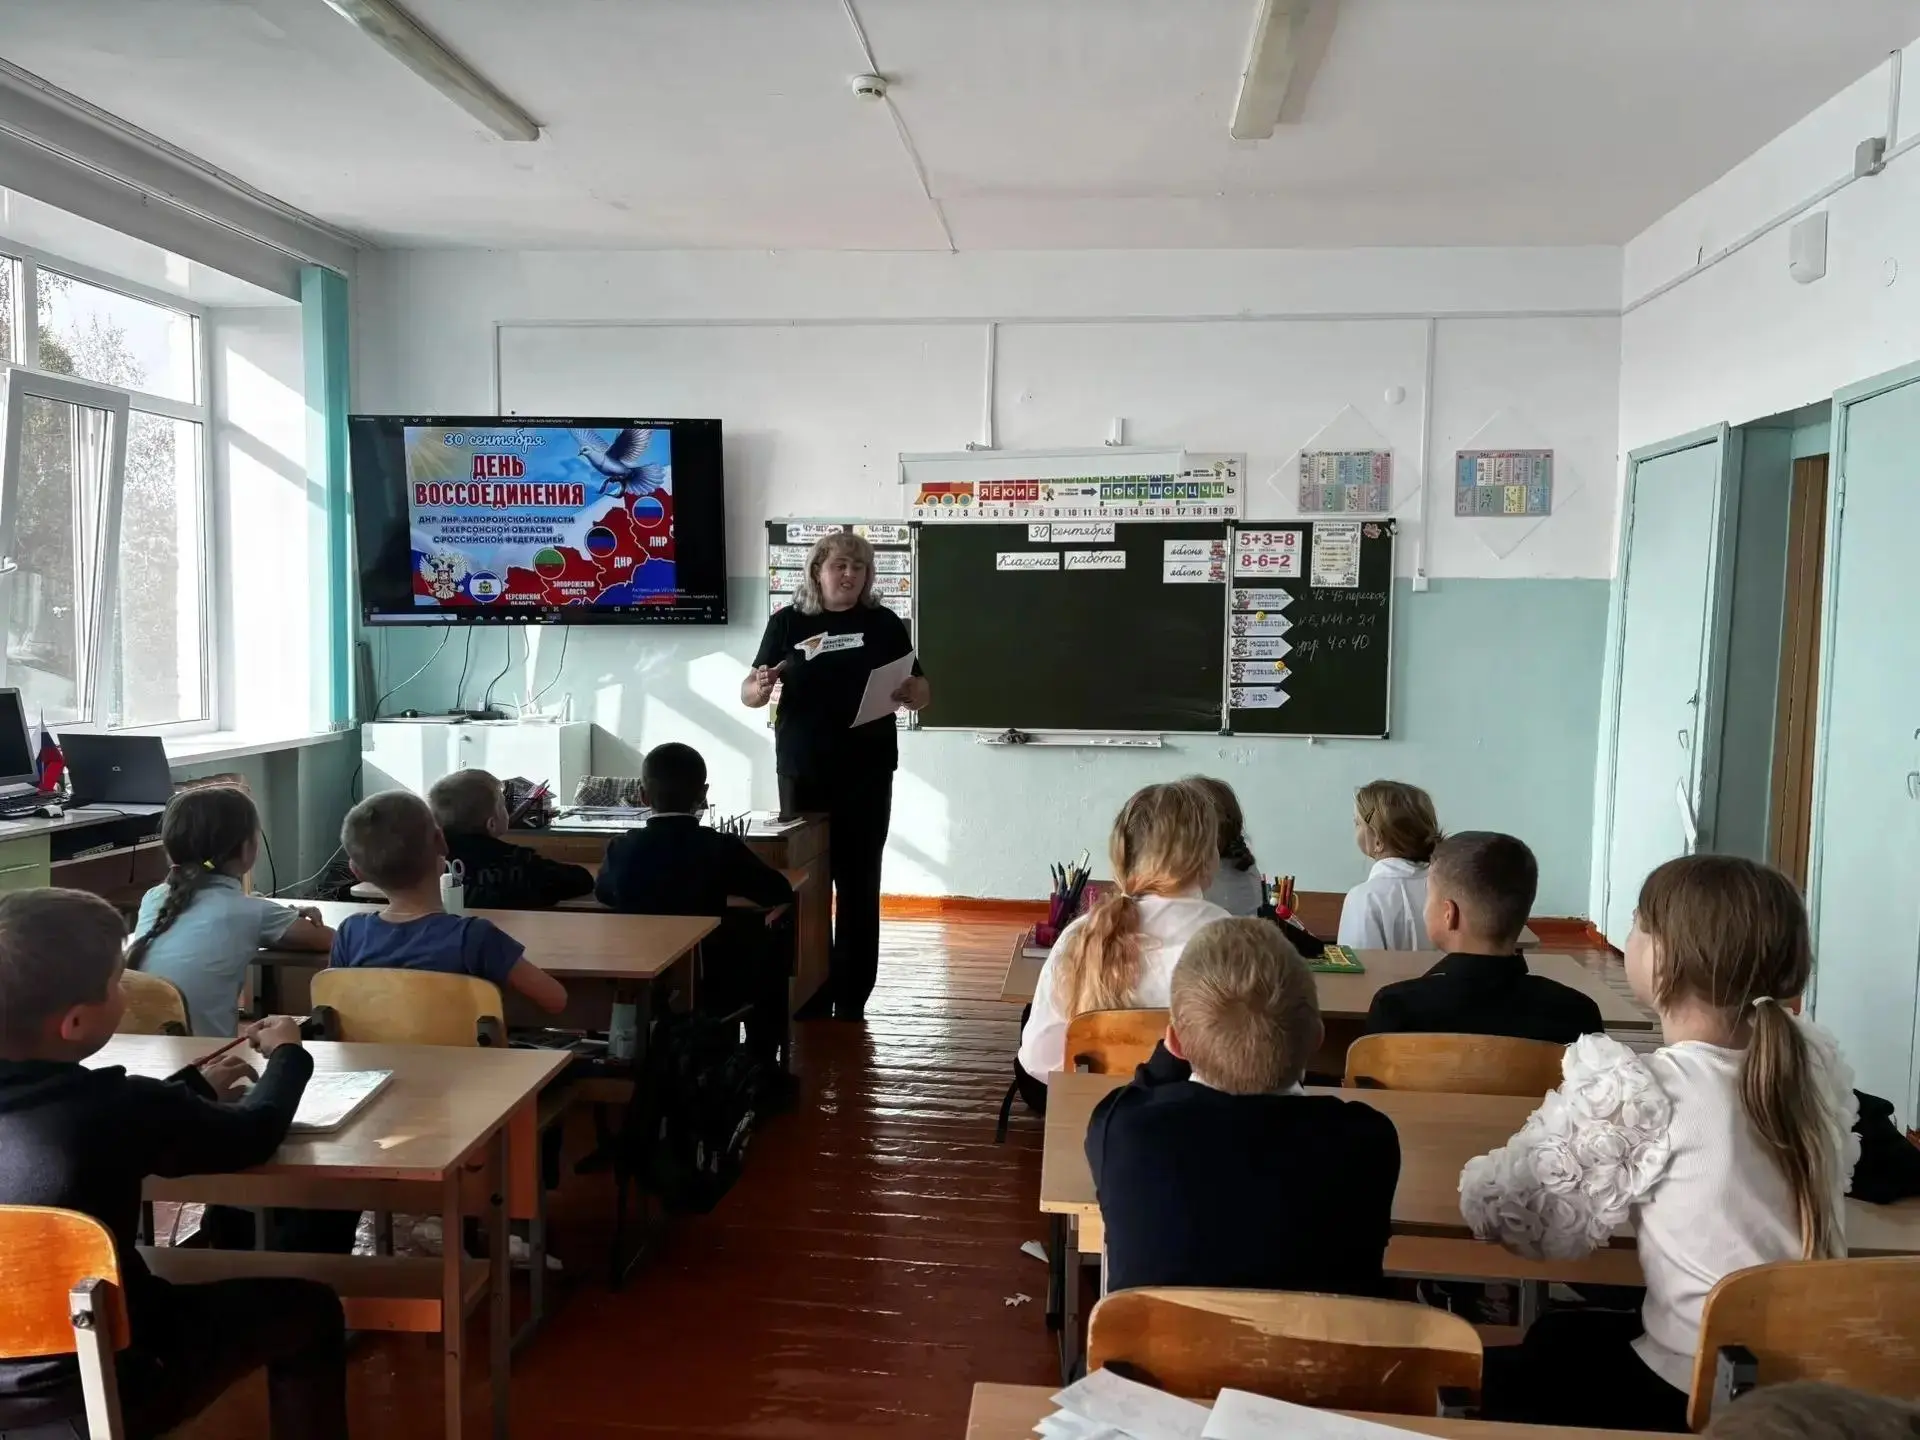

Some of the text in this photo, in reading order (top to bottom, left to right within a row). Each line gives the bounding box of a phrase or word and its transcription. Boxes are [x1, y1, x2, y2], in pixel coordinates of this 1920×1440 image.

[444, 429, 547, 453] 30 сентября
[471, 454, 526, 481] ДЕНЬ
[414, 482, 586, 510] ВОССОЕДИНЕНИЯ
[1068, 509, 1077, 517] 10
[1083, 509, 1092, 517] 11
[1145, 508, 1155, 516] 15
[1161, 508, 1170, 516] 16
[1208, 507, 1218, 515] 19
[1224, 507, 1234, 515] 20
[462, 514, 532, 524] ЗАПОРОЖСКОЙ
[533, 516, 575, 524] ОБЛАСТИ
[449, 524, 510, 534] ХЕРСОНСКОЙ
[511, 525, 553, 534] ОБЛАСТИ
[1030, 522, 1114, 542] 30 сентября
[440, 534, 504, 544] РОССИЙСКОЙ
[505, 534, 565, 544] ФЕДЕРАЦИЕЙ
[649, 535, 668, 548] ЛНР
[1241, 532, 1295, 546] 5+3=8
[613, 556, 633, 569] ДНР
[998, 554, 1059, 567] Классная
[1241, 554, 1291, 567] 8-6=2
[552, 580, 595, 588] ЗАПОРОЖСКАЯ
[561, 588, 588, 596] ОБЛАСТЬ
